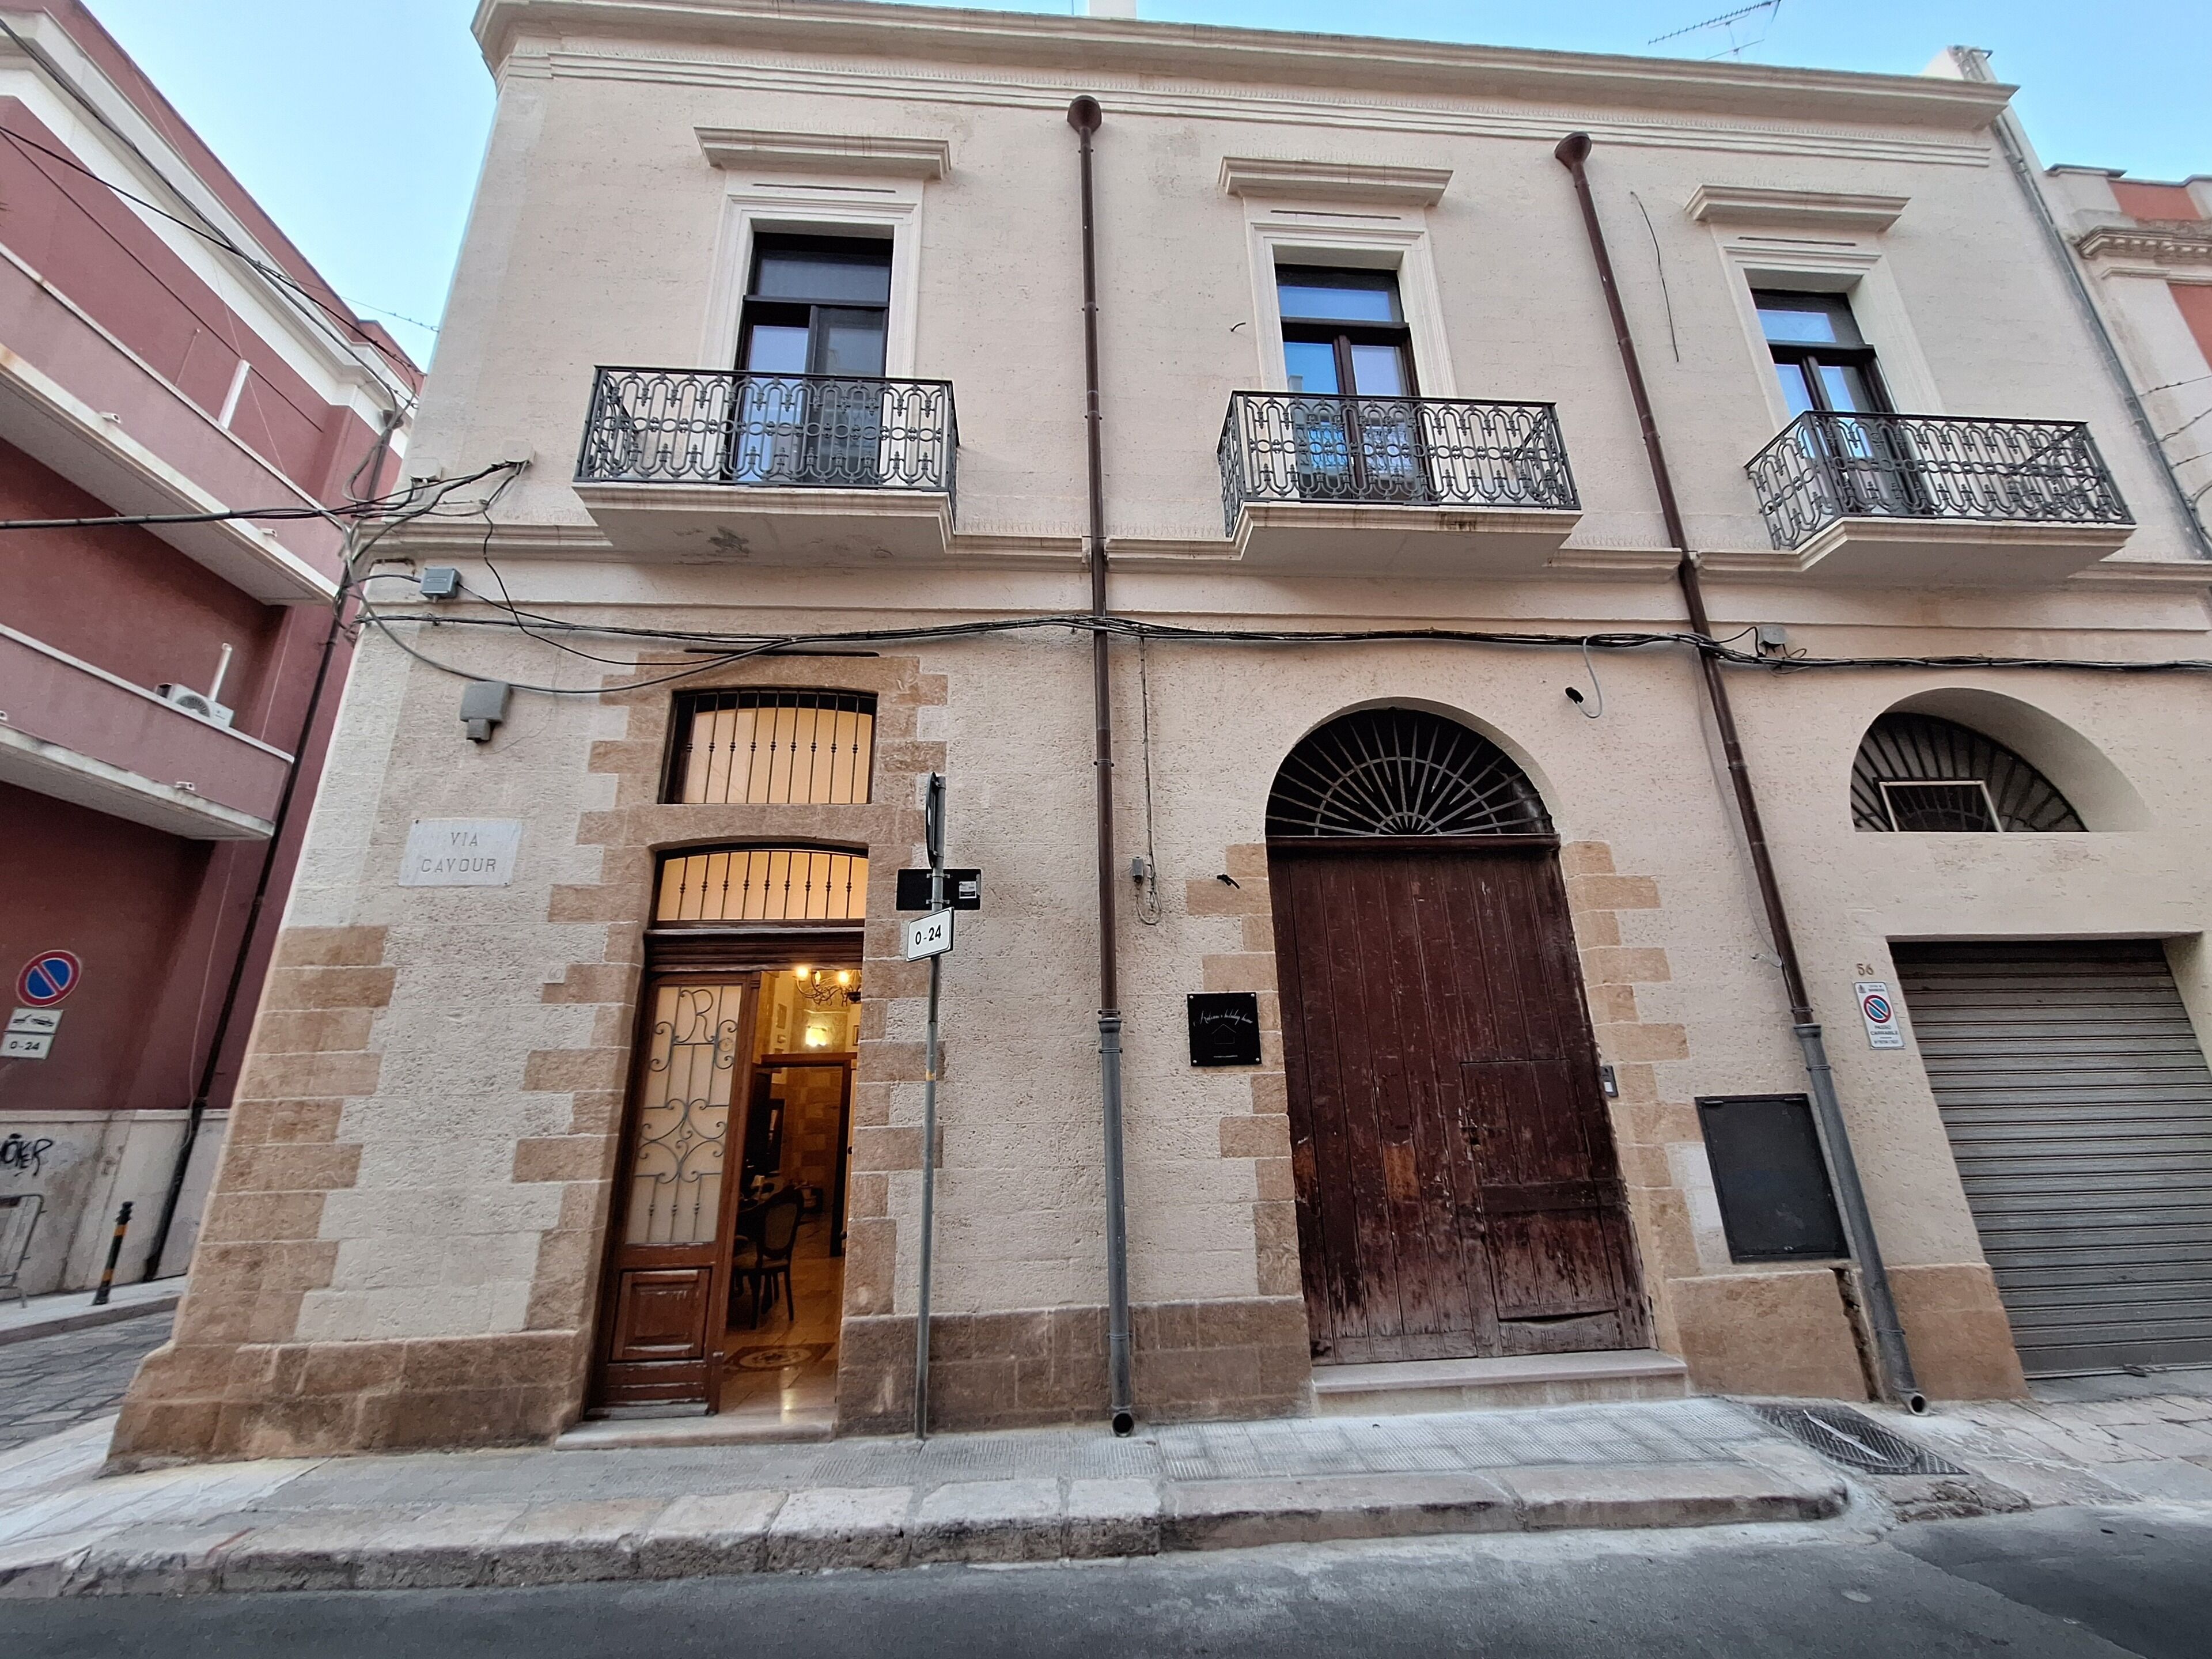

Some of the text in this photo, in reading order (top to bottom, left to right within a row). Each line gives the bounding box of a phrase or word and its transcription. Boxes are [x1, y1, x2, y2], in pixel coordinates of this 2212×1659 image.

[450, 832, 478, 846] VIA
[421, 858, 497, 873] CAVOUR
[1856, 963, 1874, 975] 56
